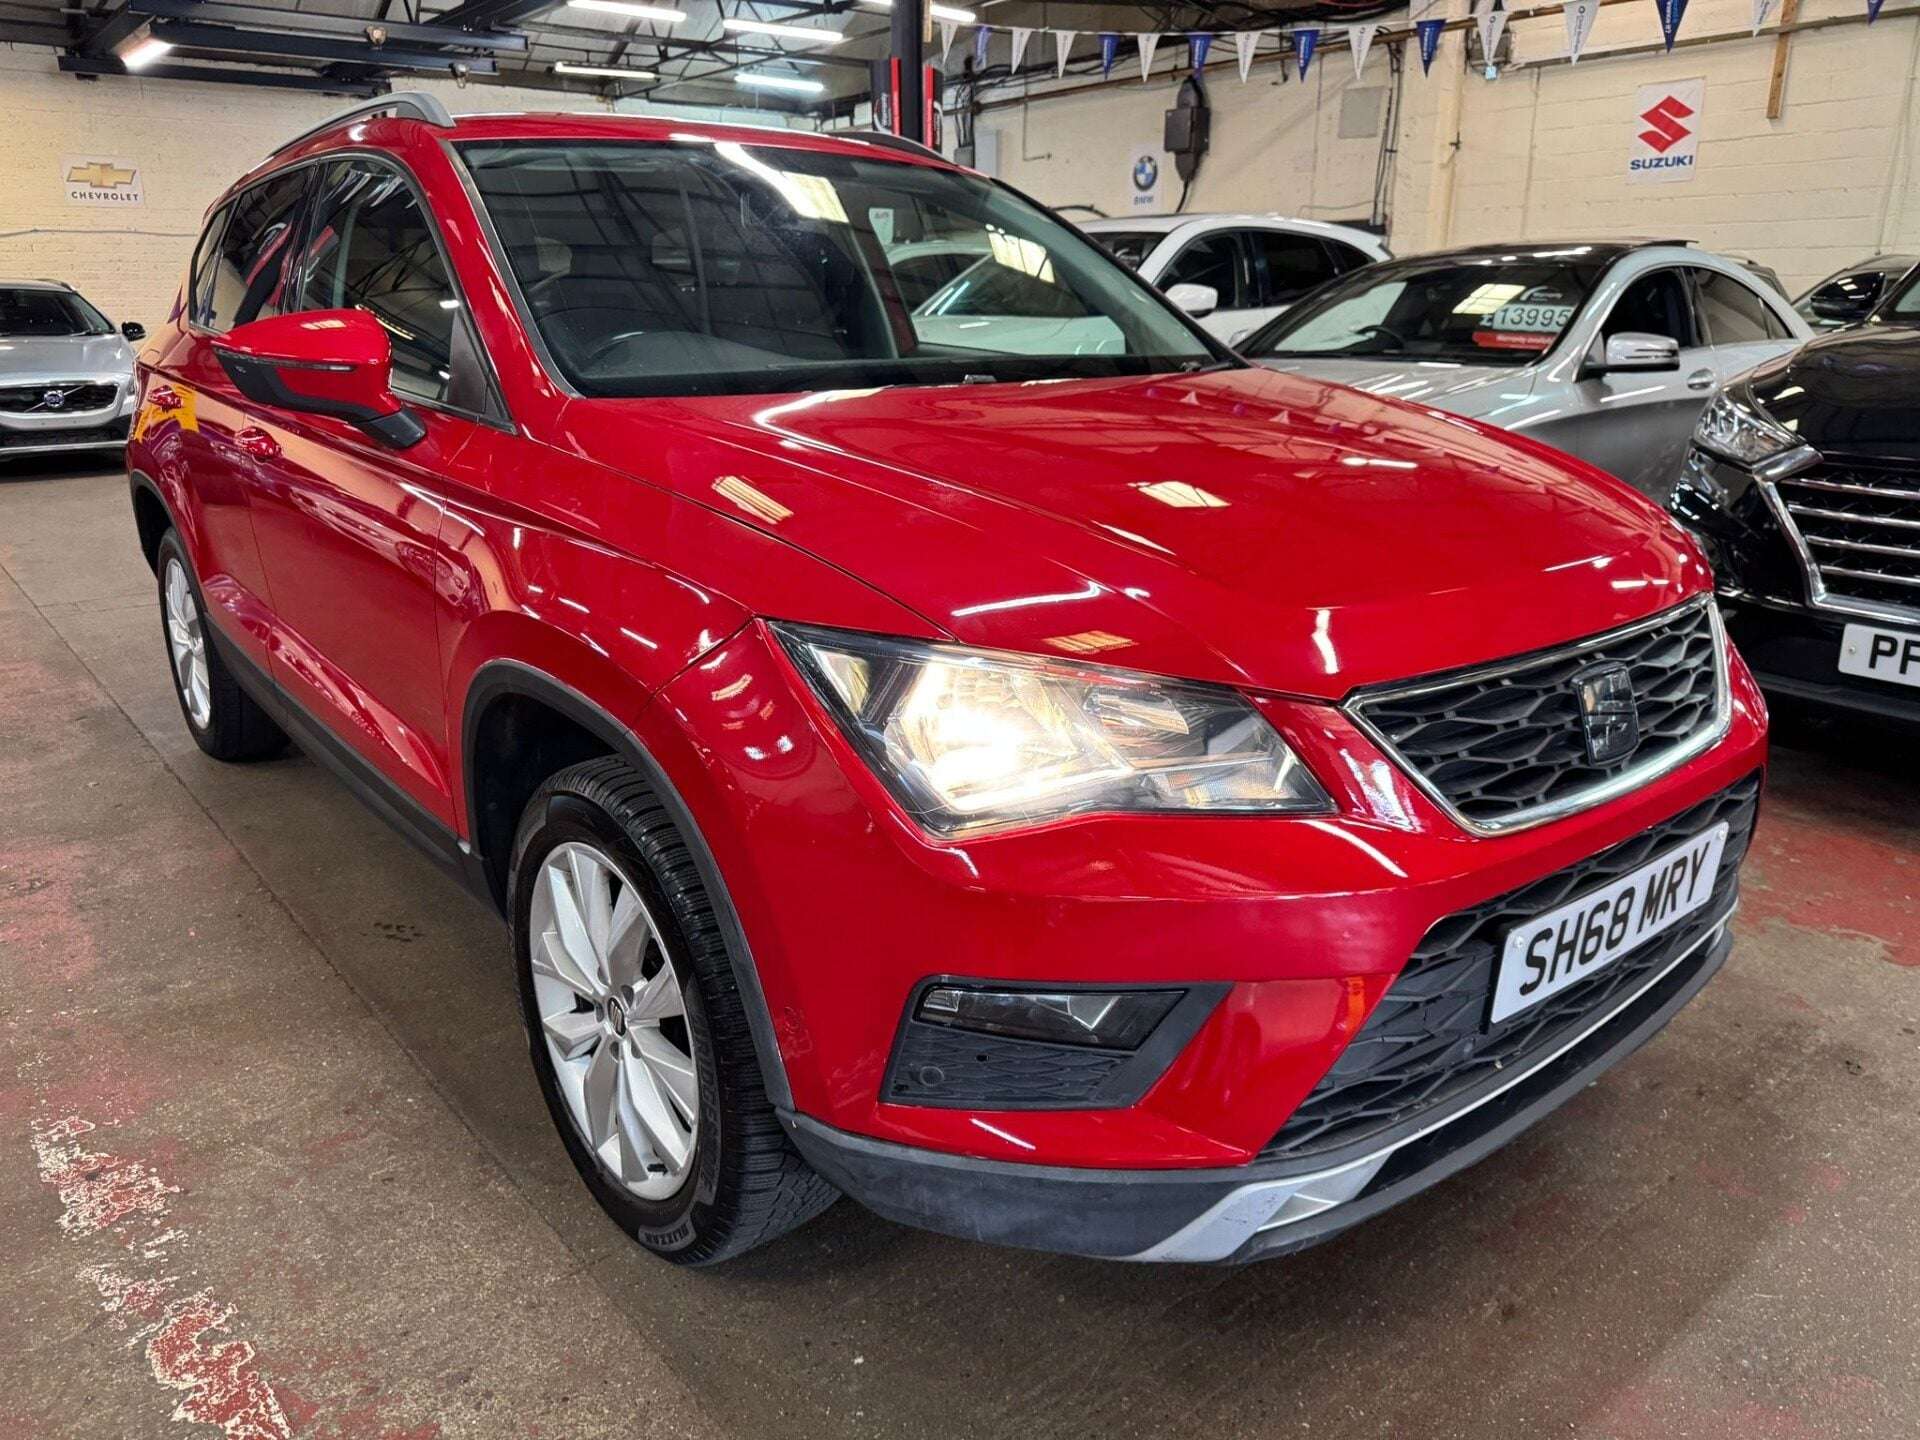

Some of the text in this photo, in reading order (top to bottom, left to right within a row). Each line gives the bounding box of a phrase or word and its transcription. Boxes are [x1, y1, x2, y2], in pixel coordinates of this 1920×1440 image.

[1630, 155, 1693, 170] SUZUKI
[71, 191, 138, 201] CHEVROLET
[1519, 841, 1710, 996] SH68 MRY
